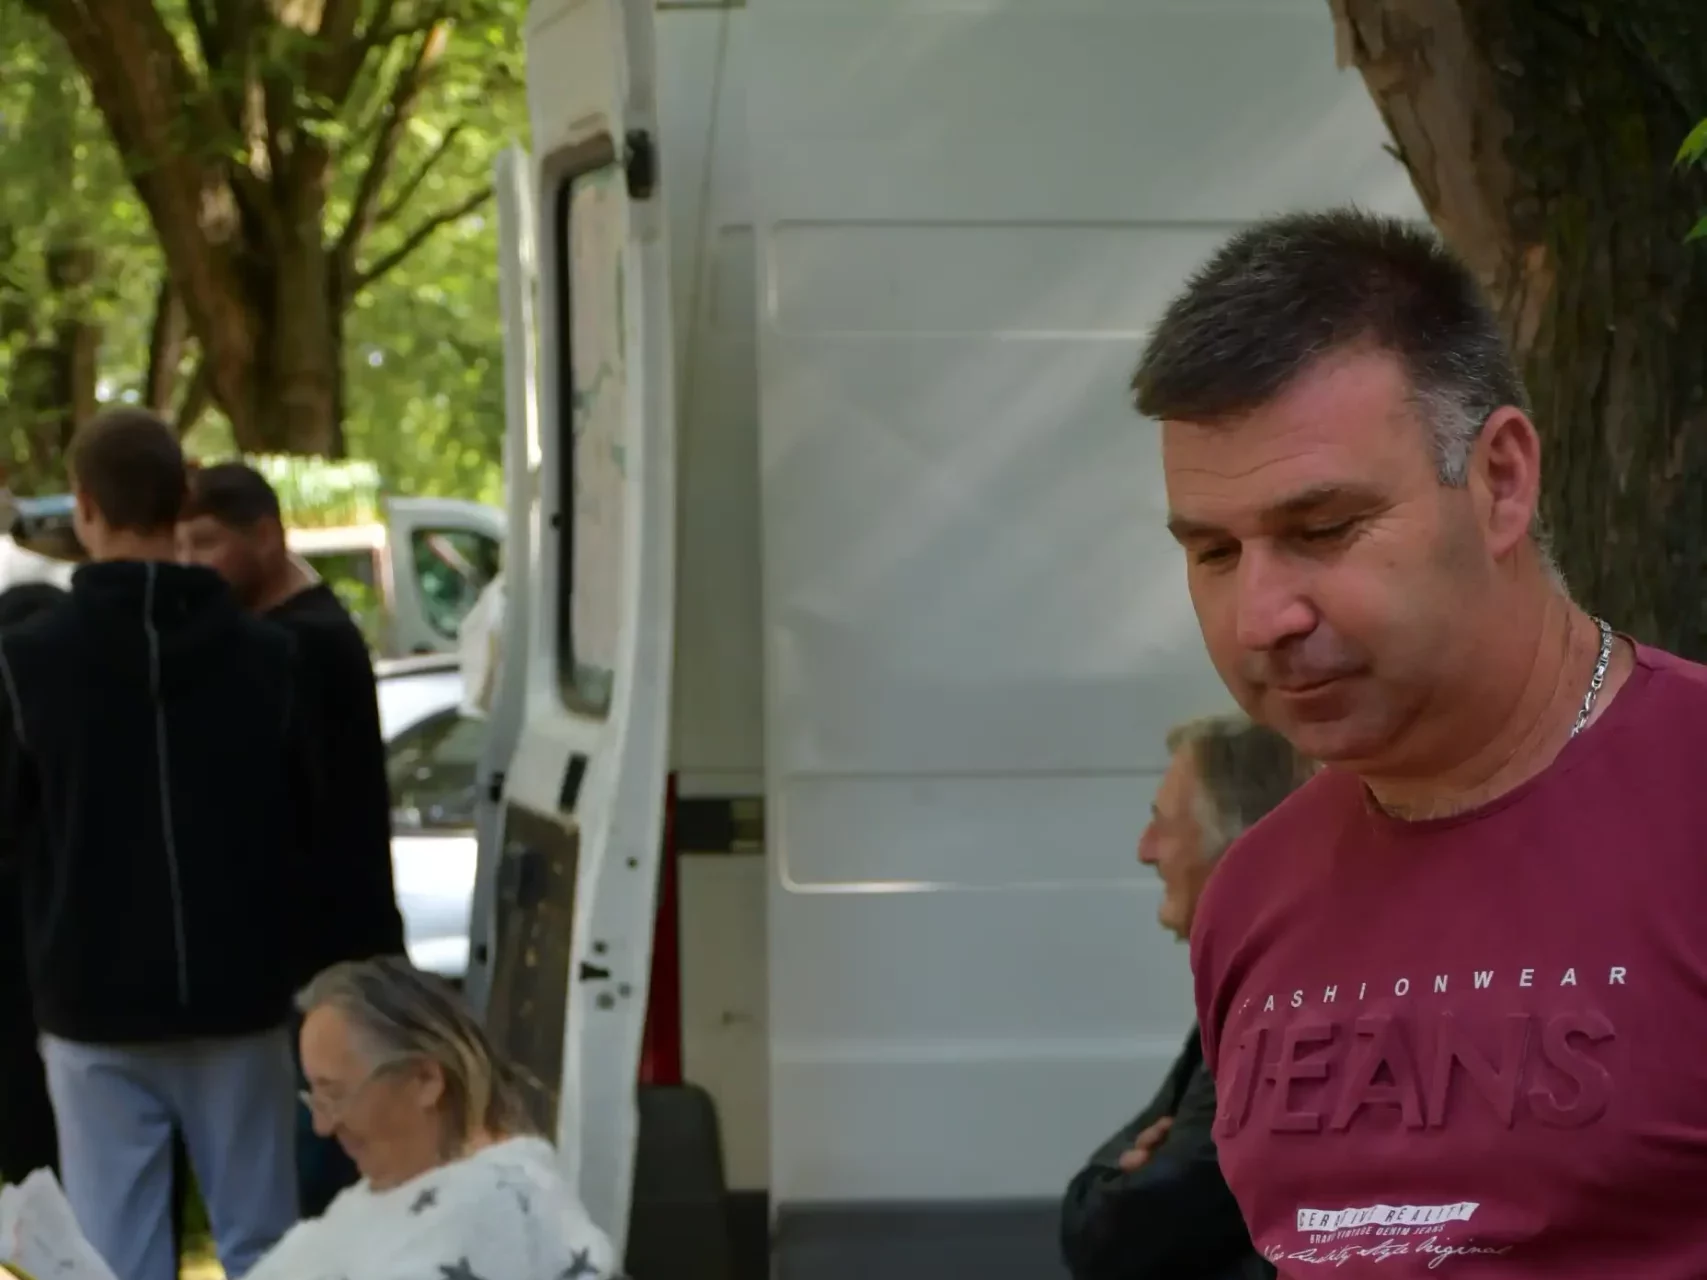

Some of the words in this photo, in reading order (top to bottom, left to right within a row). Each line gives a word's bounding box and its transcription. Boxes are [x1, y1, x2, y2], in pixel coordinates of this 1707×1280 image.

[1212, 1010, 1618, 1138] JEANS
[1384, 1204, 1469, 1223] REALITY
[1376, 1226, 1411, 1236] DENIM
[1412, 1223, 1446, 1236] JEANS
